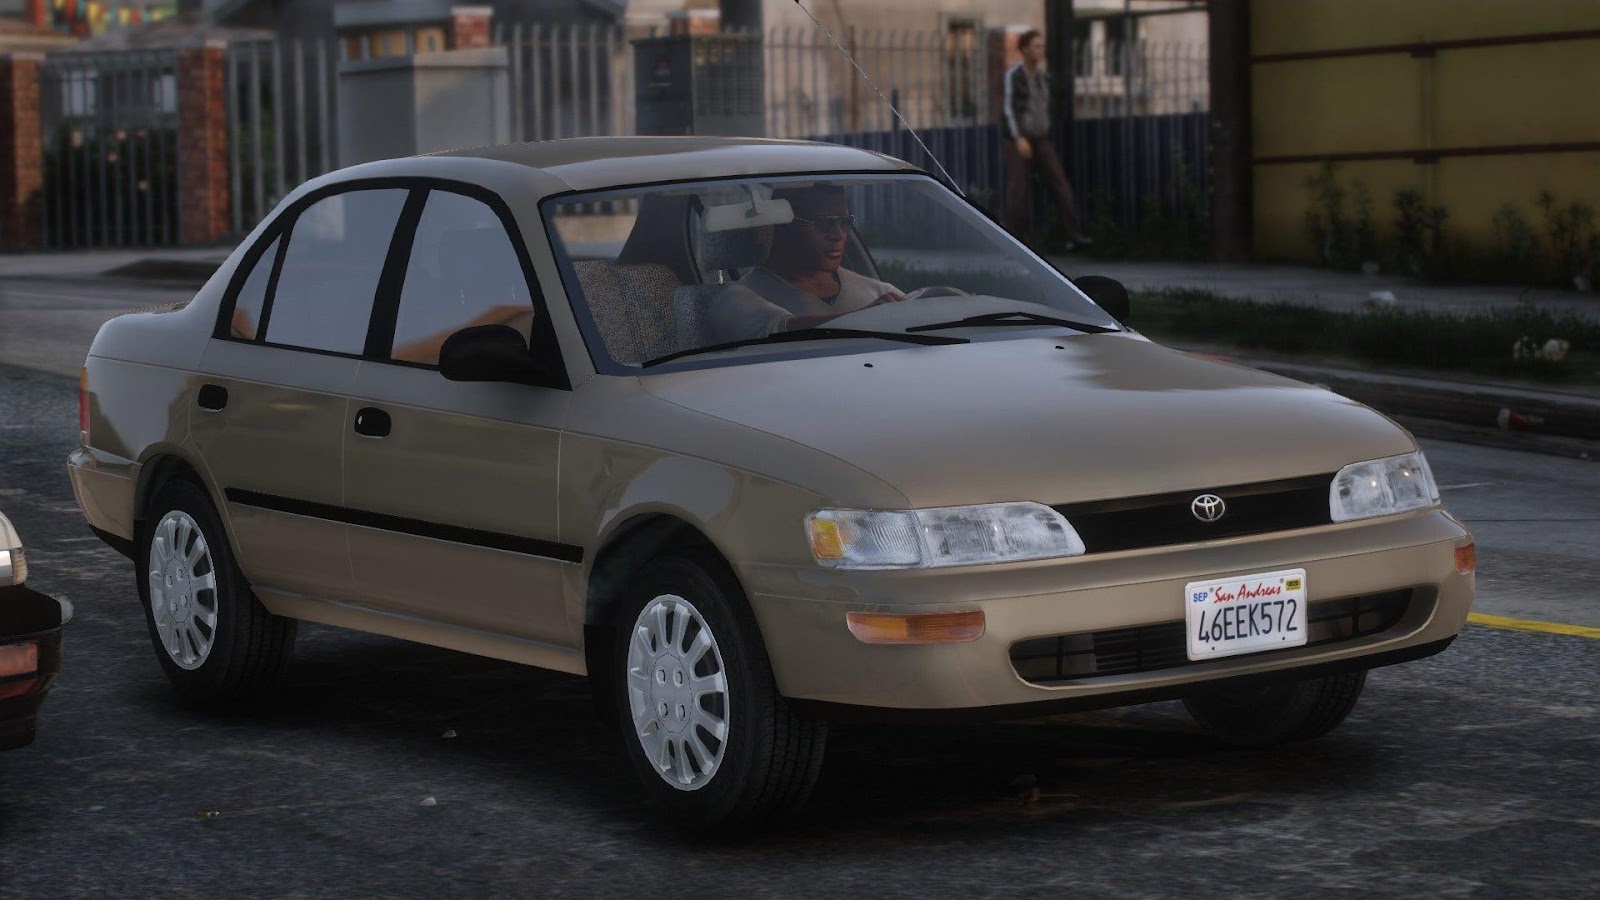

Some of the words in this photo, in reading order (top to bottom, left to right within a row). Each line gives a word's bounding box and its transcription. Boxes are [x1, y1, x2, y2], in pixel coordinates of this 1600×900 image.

[1193, 592, 1208, 602] SEP
[1214, 586, 1234, 603] San
[1237, 583, 1281, 600] Andreas
[1198, 599, 1297, 643] 46EEK572
